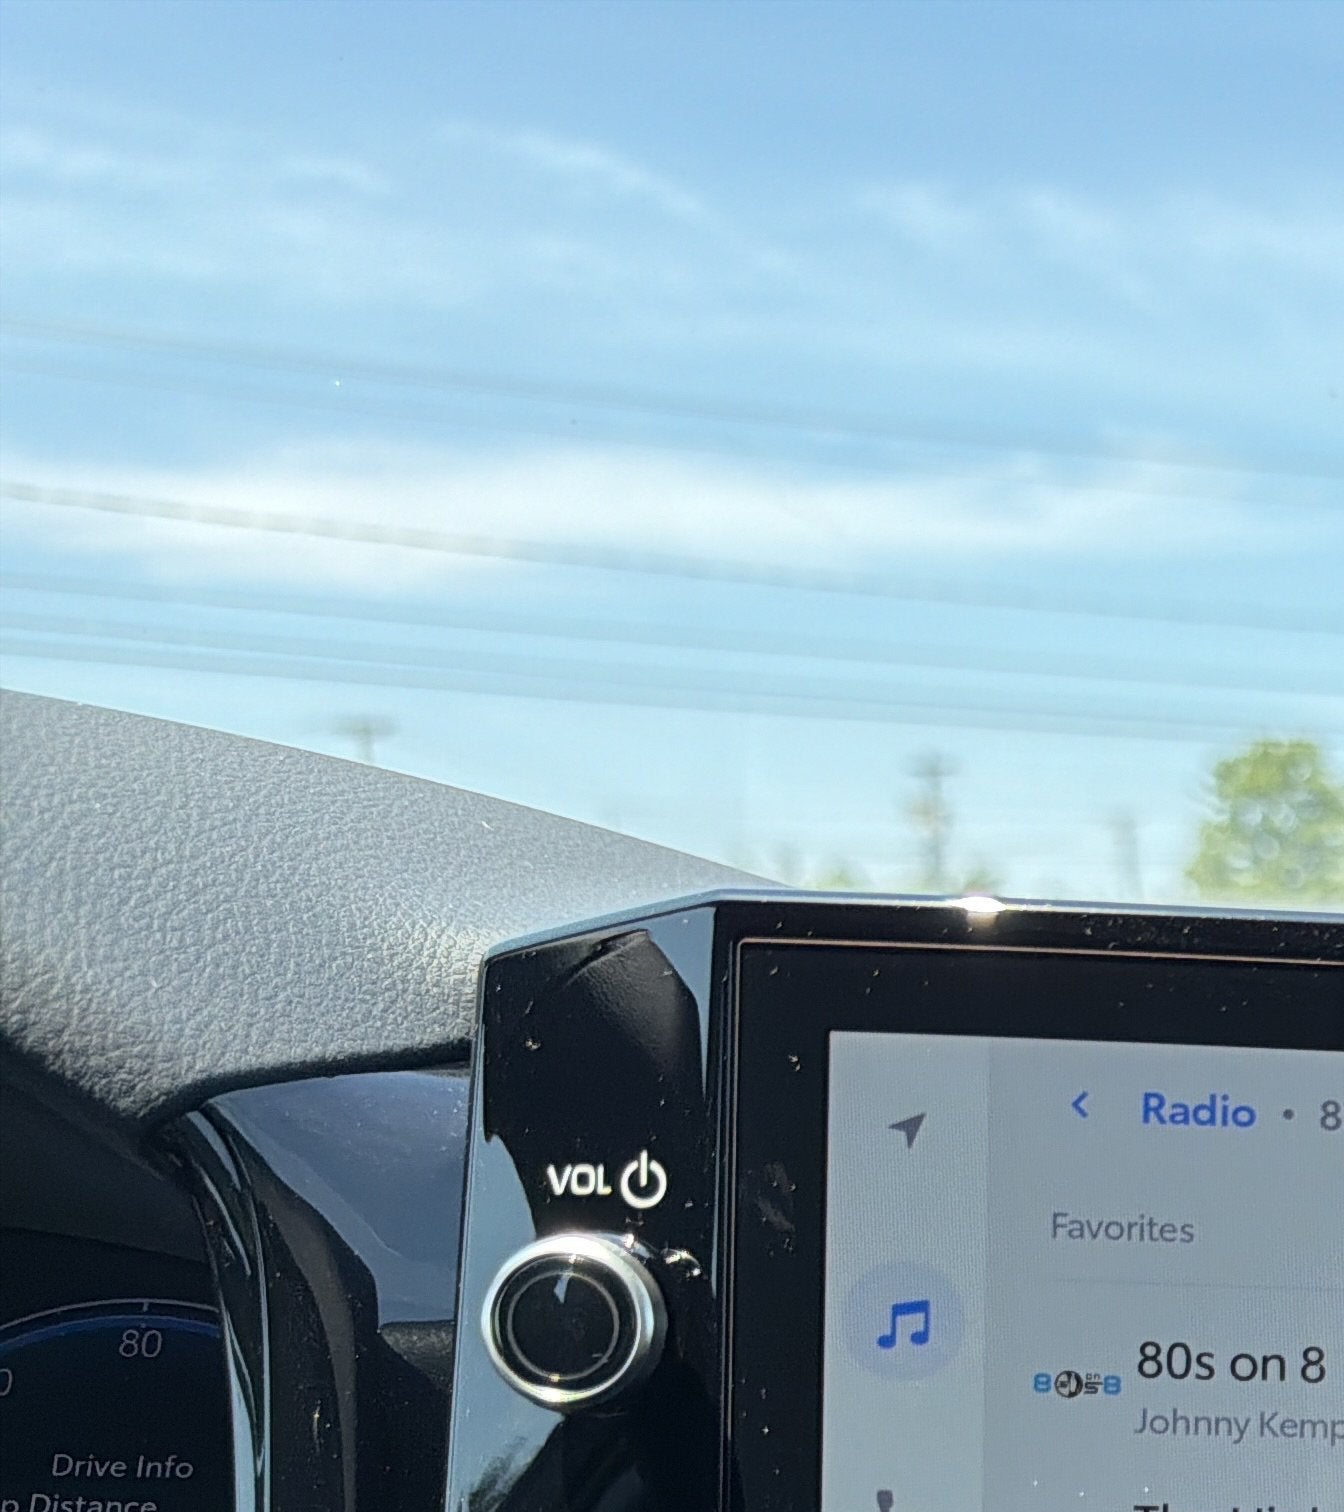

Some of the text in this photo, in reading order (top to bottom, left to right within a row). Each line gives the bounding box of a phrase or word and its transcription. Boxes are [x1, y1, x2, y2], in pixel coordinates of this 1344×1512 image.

[1141, 1091, 1257, 1129] Radio
[546, 1163, 613, 1196] VOL
[1050, 1212, 1195, 1244] Favorites
[119, 1329, 163, 1358] 80
[1136, 1340, 1327, 1384] 80s on 8
[1133, 1407, 1250, 1444] Johnny
[51, 1453, 194, 1479] Drive Info
